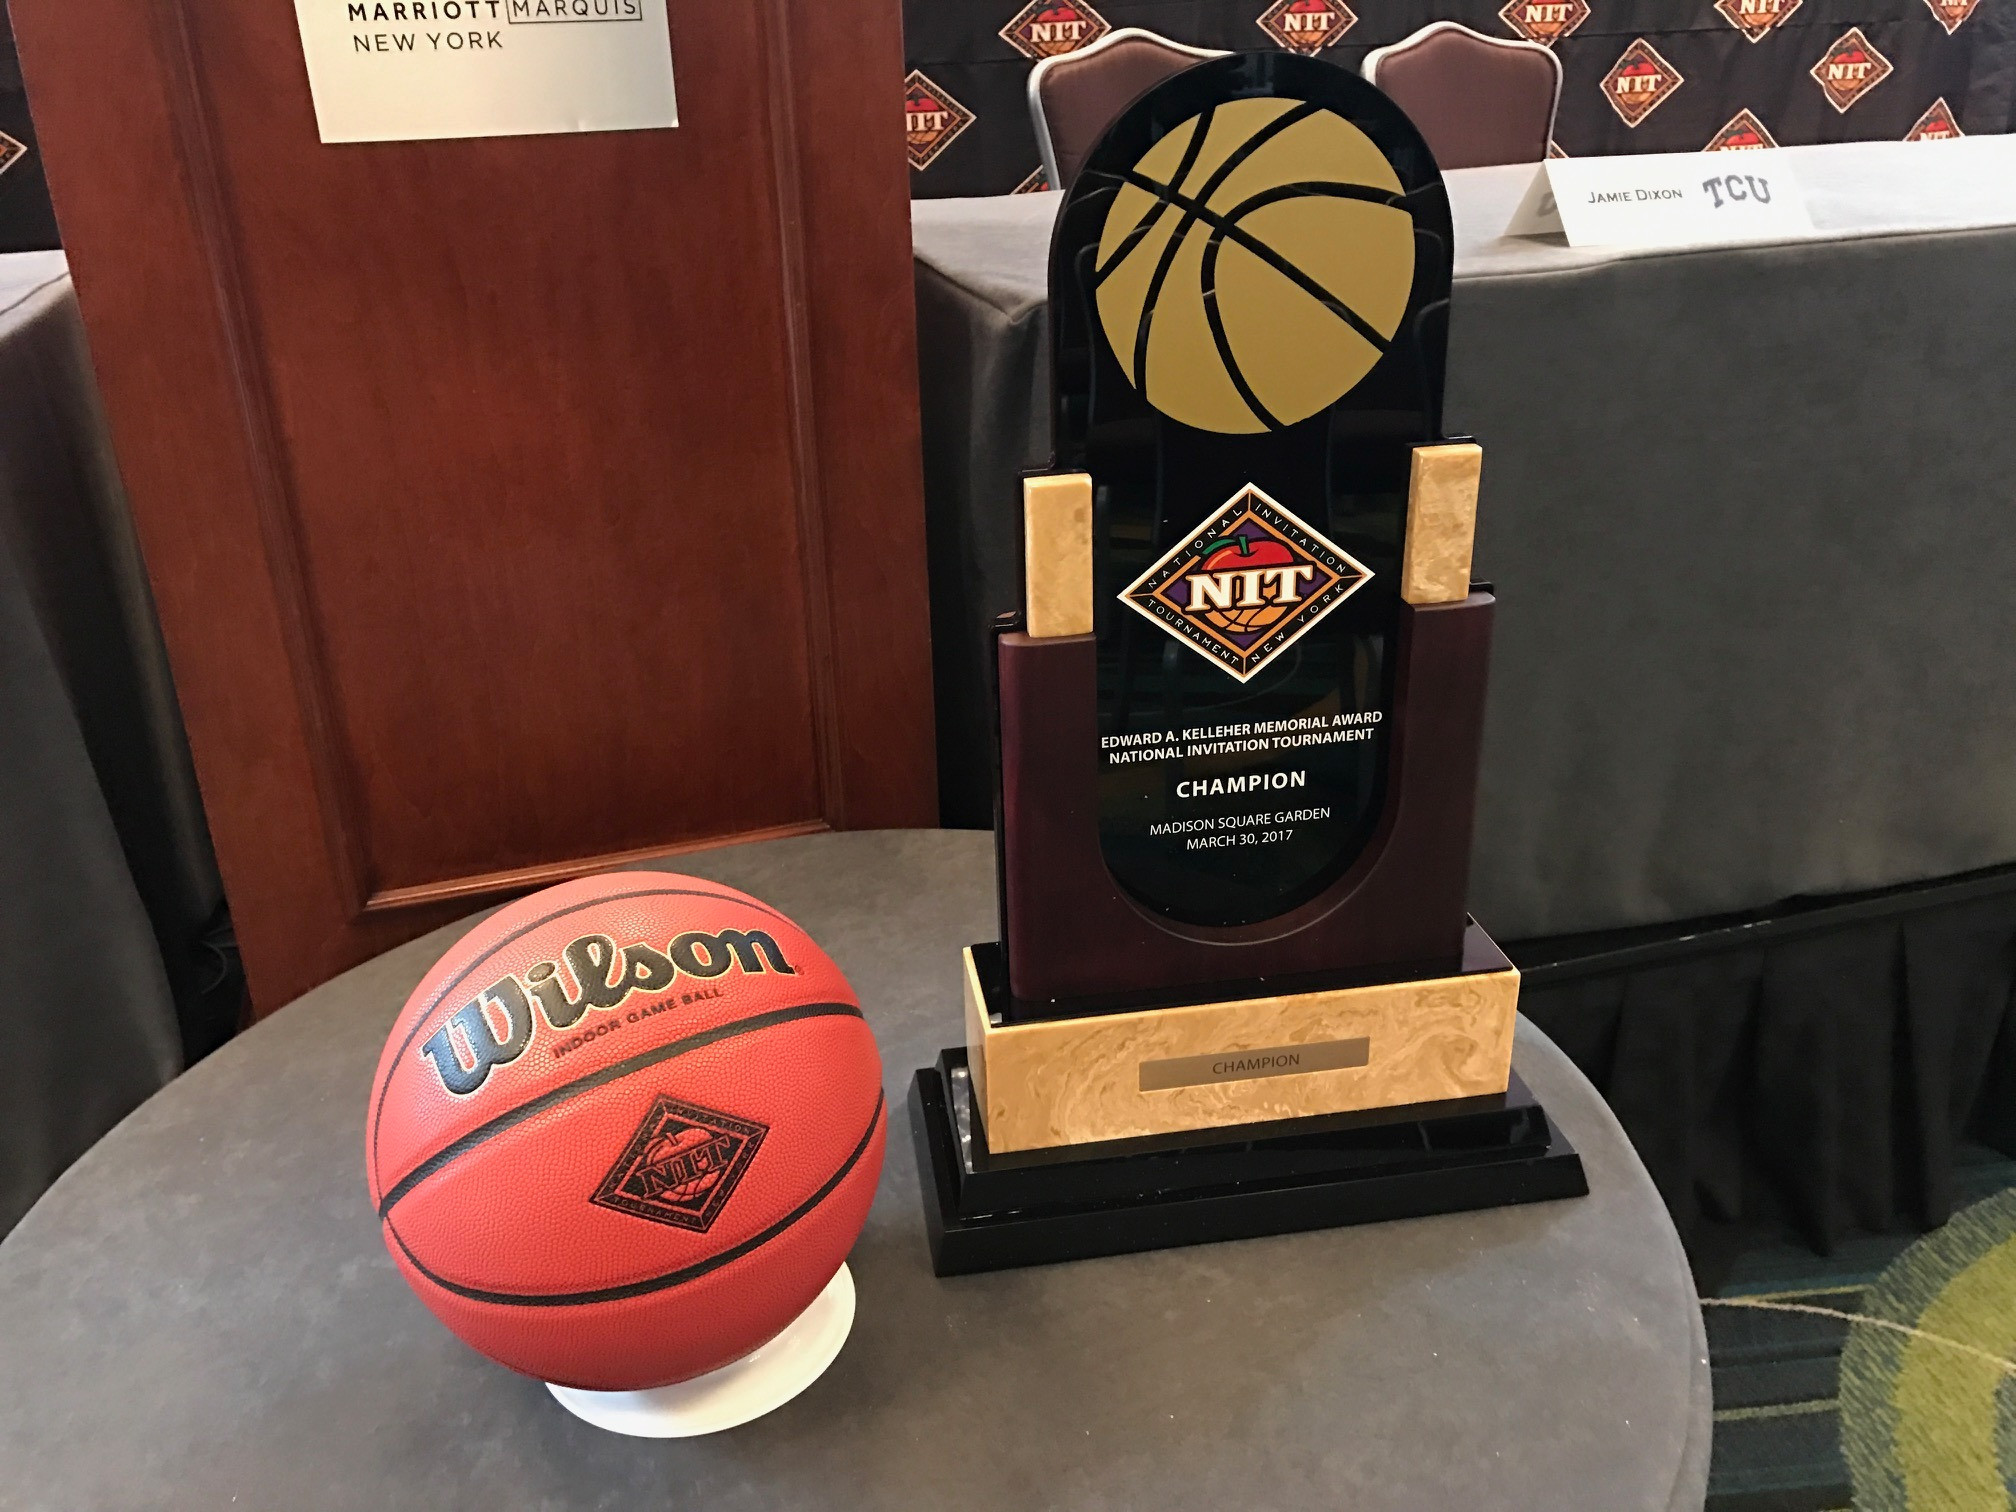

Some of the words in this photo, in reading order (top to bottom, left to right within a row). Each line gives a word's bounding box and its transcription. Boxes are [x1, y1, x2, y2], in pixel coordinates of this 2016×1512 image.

[349, 1, 500, 21] MARRIOTT
[513, 0, 636, 17] MARQUIS
[1284, 12, 1335, 32] NIT
[1525, 3, 1573, 23] NIT
[353, 33, 415, 53] NEW
[427, 31, 503, 50] YORK
[1029, 20, 1087, 43] NIT
[1616, 74, 1661, 94] NIT
[1827, 62, 1872, 81] NIT
[1702, 174, 1772, 209] TCU
[1148, 509, 1242, 588] NATIONAL
[1255, 503, 1346, 573] INVITATION
[1185, 564, 1314, 611] NIT
[1148, 599, 1239, 664] TOURNAMENT
[1251, 632, 1285, 663] NEW
[1297, 583, 1344, 624] YORK
[1101, 732, 1162, 748] EDWARD
[1165, 730, 1179, 743] A.
[1183, 723, 1251, 741] KELLEHER
[1254, 715, 1329, 734] MEMORIAL
[1332, 710, 1383, 726] AWARD
[1109, 746, 1183, 764] NATIONAL
[1187, 738, 1269, 756] INVITATION
[1272, 728, 1374, 749] TOURNAMENT
[1176, 770, 1306, 798] CHAMPION
[1150, 817, 1214, 836] MADISON
[1218, 813, 1271, 830] SQUARE
[1275, 807, 1330, 822] GARDEN
[1187, 835, 1236, 851] MARCH
[1239, 834, 1258, 846] 30,
[1262, 829, 1293, 843] 2017
[420, 928, 797, 1098] Wilson
[553, 1019, 622, 1059] INDOOR
[626, 998, 678, 1024] GAME
[681, 988, 724, 1006] BALL
[1213, 1054, 1300, 1074] CHAMPION
[636, 1135, 730, 1197] NIT
[614, 1197, 697, 1224] TOURNAMENT
